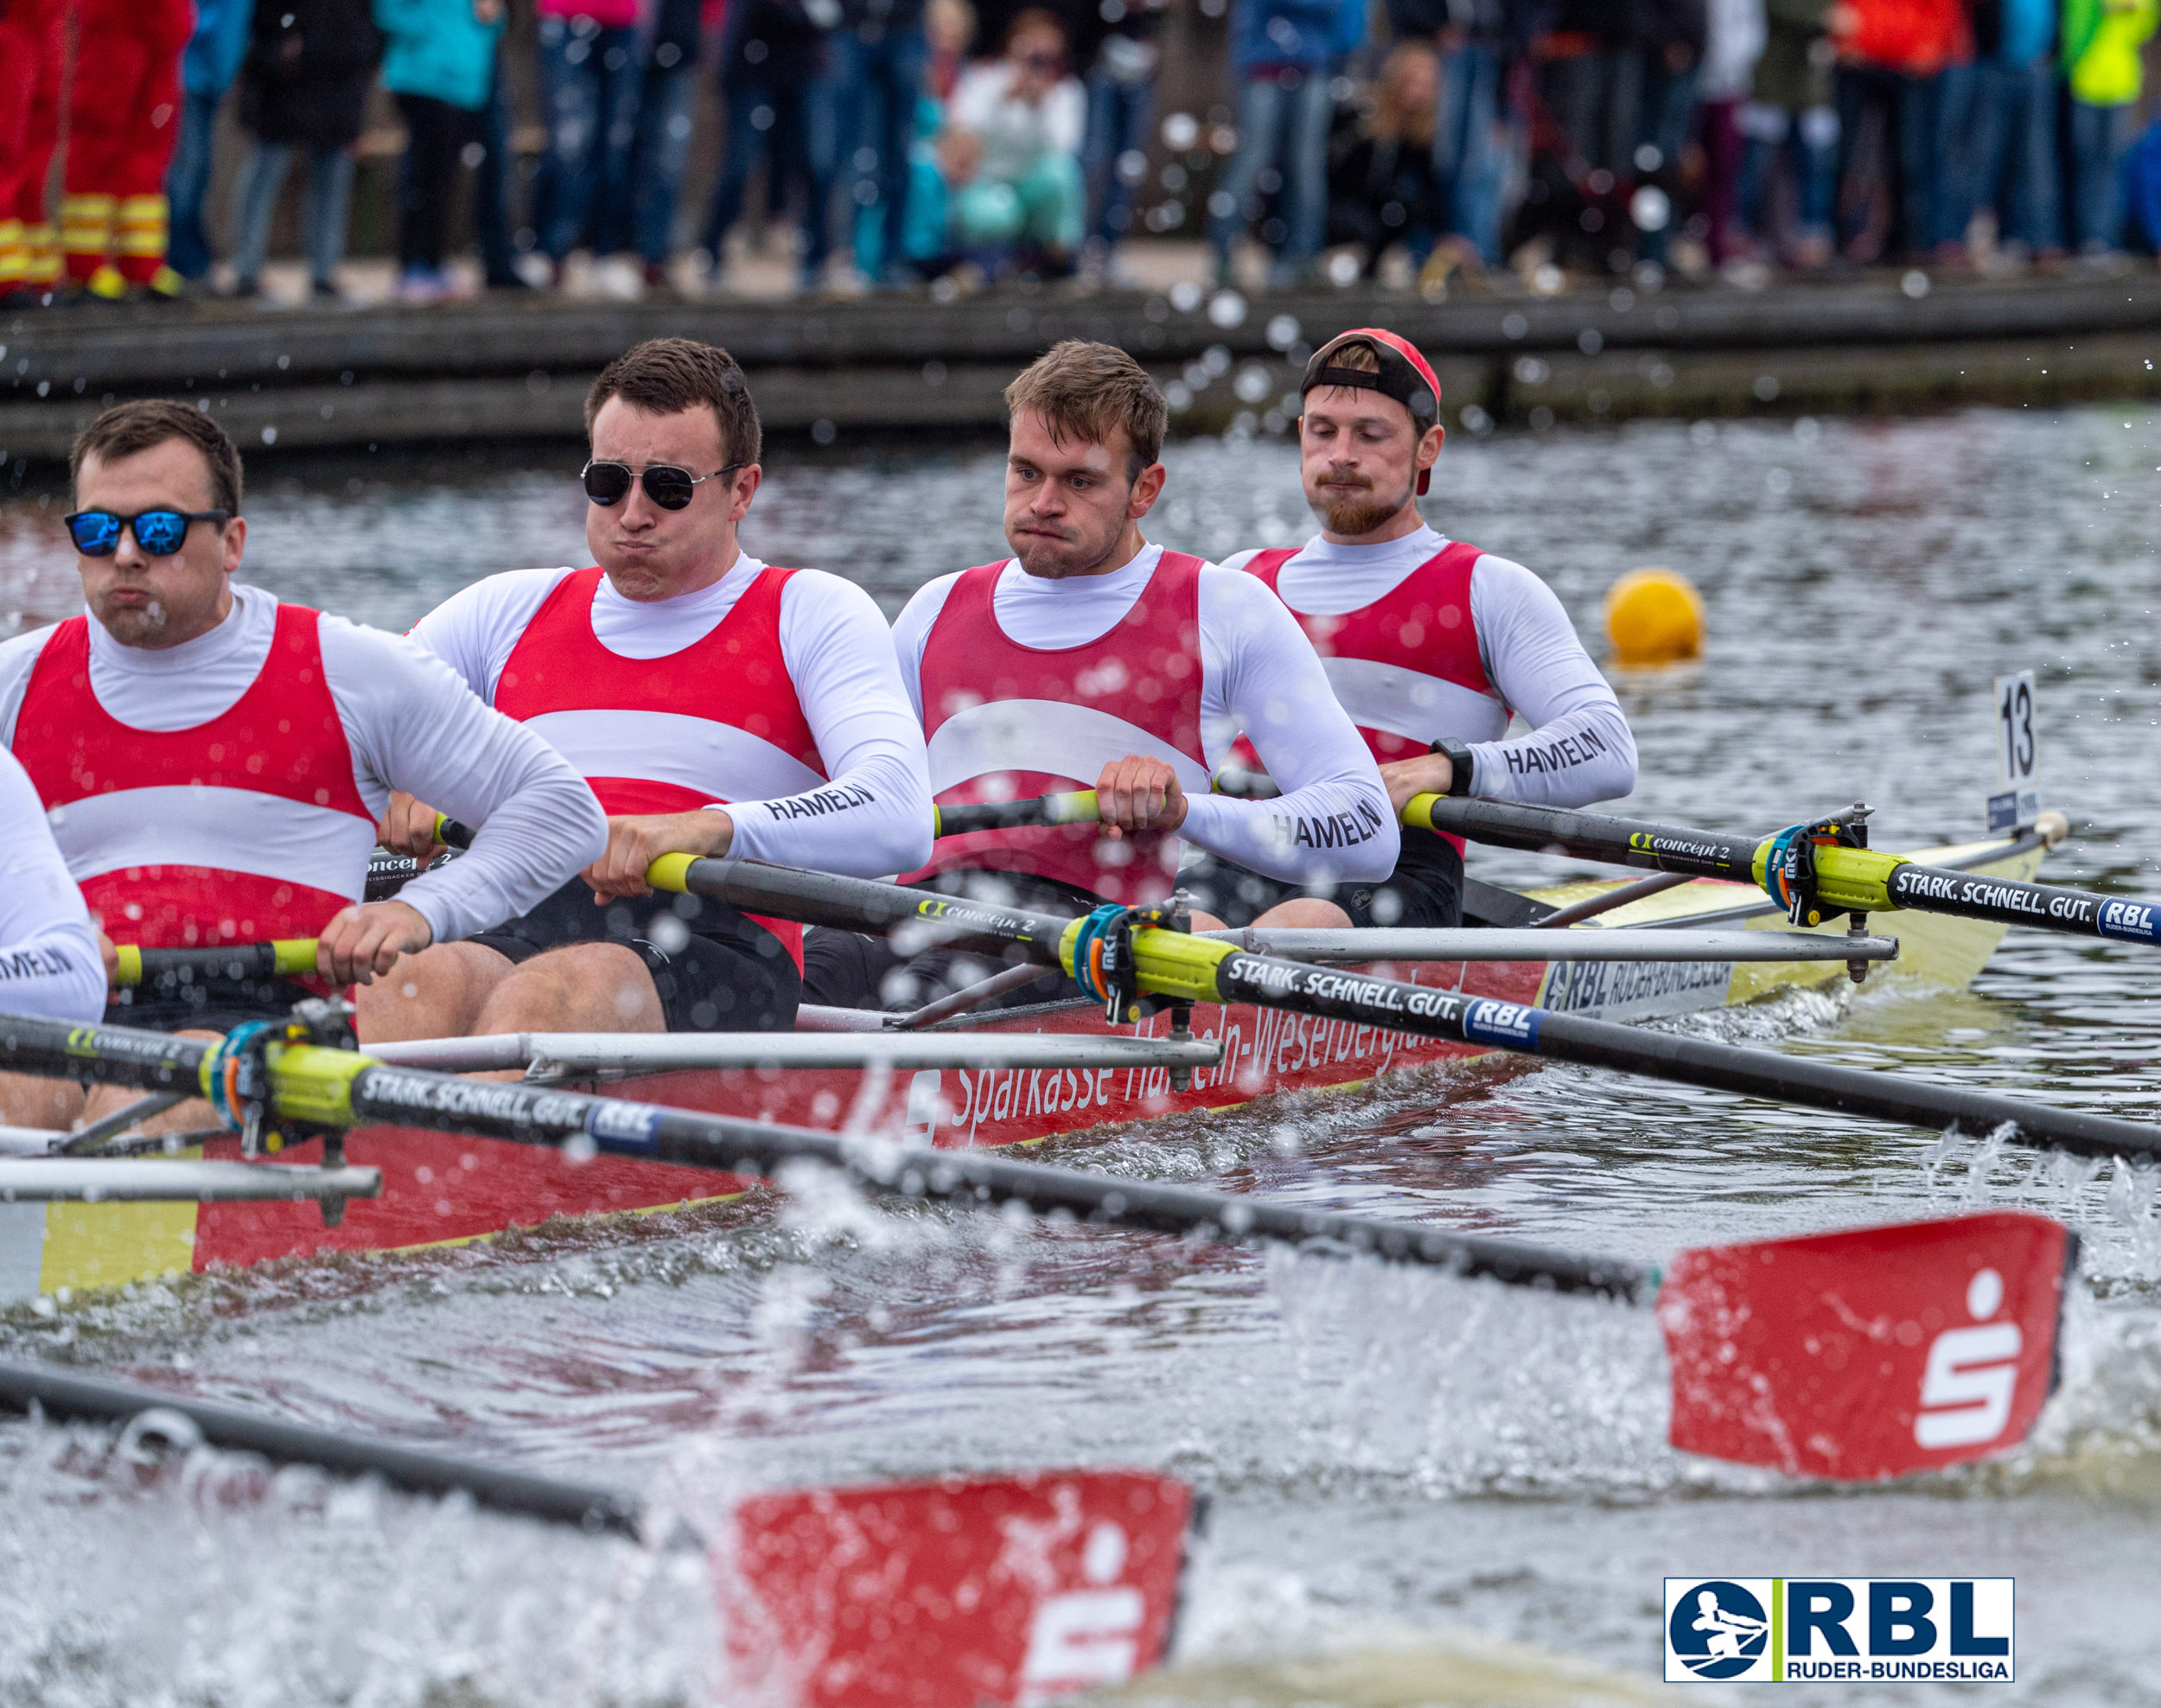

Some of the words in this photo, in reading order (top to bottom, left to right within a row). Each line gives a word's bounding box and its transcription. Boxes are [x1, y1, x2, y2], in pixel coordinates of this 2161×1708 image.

[1502, 727, 1607, 774] HAMELN
[2001, 682, 2034, 780] 13
[762, 782, 875, 820] HAMELN
[1272, 799, 1382, 848] HAMELN
[1653, 837, 1717, 857] concept
[1718, 846, 1731, 860] 2
[1896, 872, 1958, 901] STARK.
[1961, 882, 2046, 915] SCHNELL.
[2049, 896, 2091, 922] GUT.
[2106, 902, 2153, 930] RBL
[1228, 958, 1300, 992] STARK.
[1304, 972, 1405, 1012] SCHNELL.
[1407, 992, 1457, 1021] GUT.
[1474, 1000, 1532, 1031] RBL
